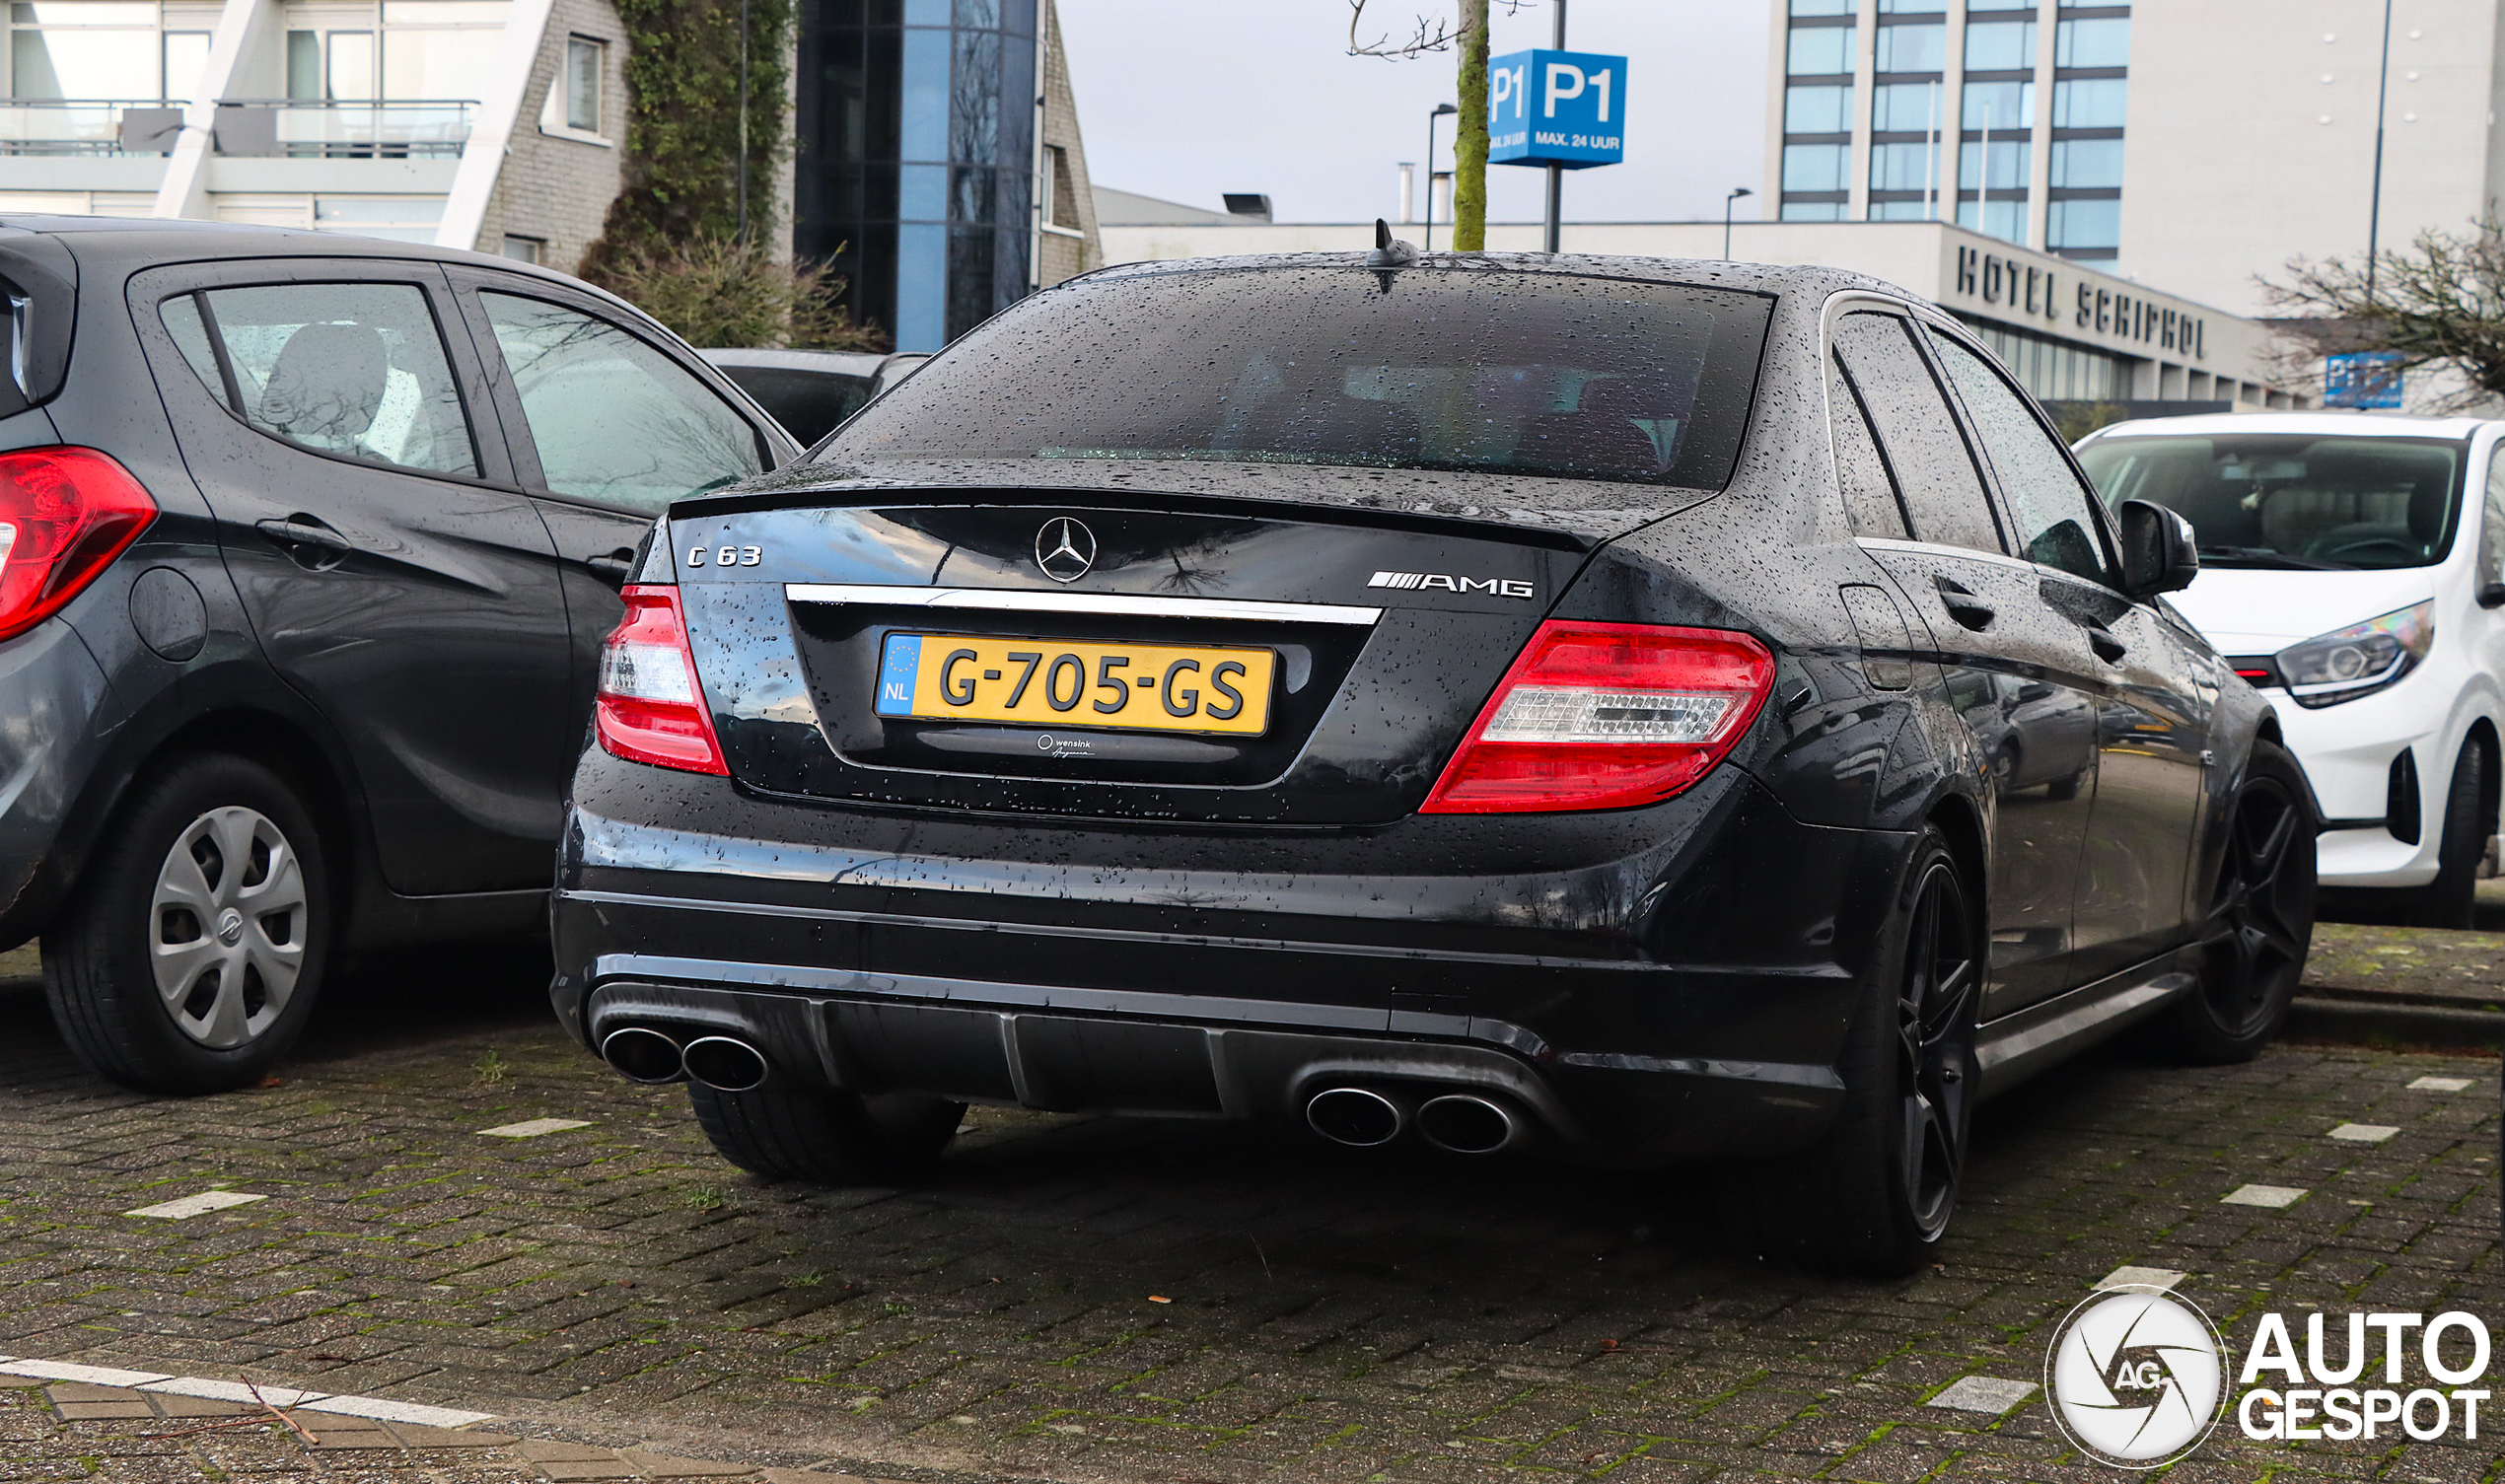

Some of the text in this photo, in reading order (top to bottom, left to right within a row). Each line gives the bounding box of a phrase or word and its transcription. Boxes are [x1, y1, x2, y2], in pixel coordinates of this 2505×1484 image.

[1491, 64, 1524, 123] P1
[1543, 62, 1610, 123] P1
[1535, 131, 1620, 150] MAX. 24 UUR
[1958, 246, 2206, 360] HOTEL SCHIPHOL
[687, 545, 762, 568] C 63
[1417, 574, 1534, 599] AMG
[885, 682, 908, 700] NL
[939, 648, 1247, 721] G-705-GS
[1055, 740, 1091, 748] wensink
